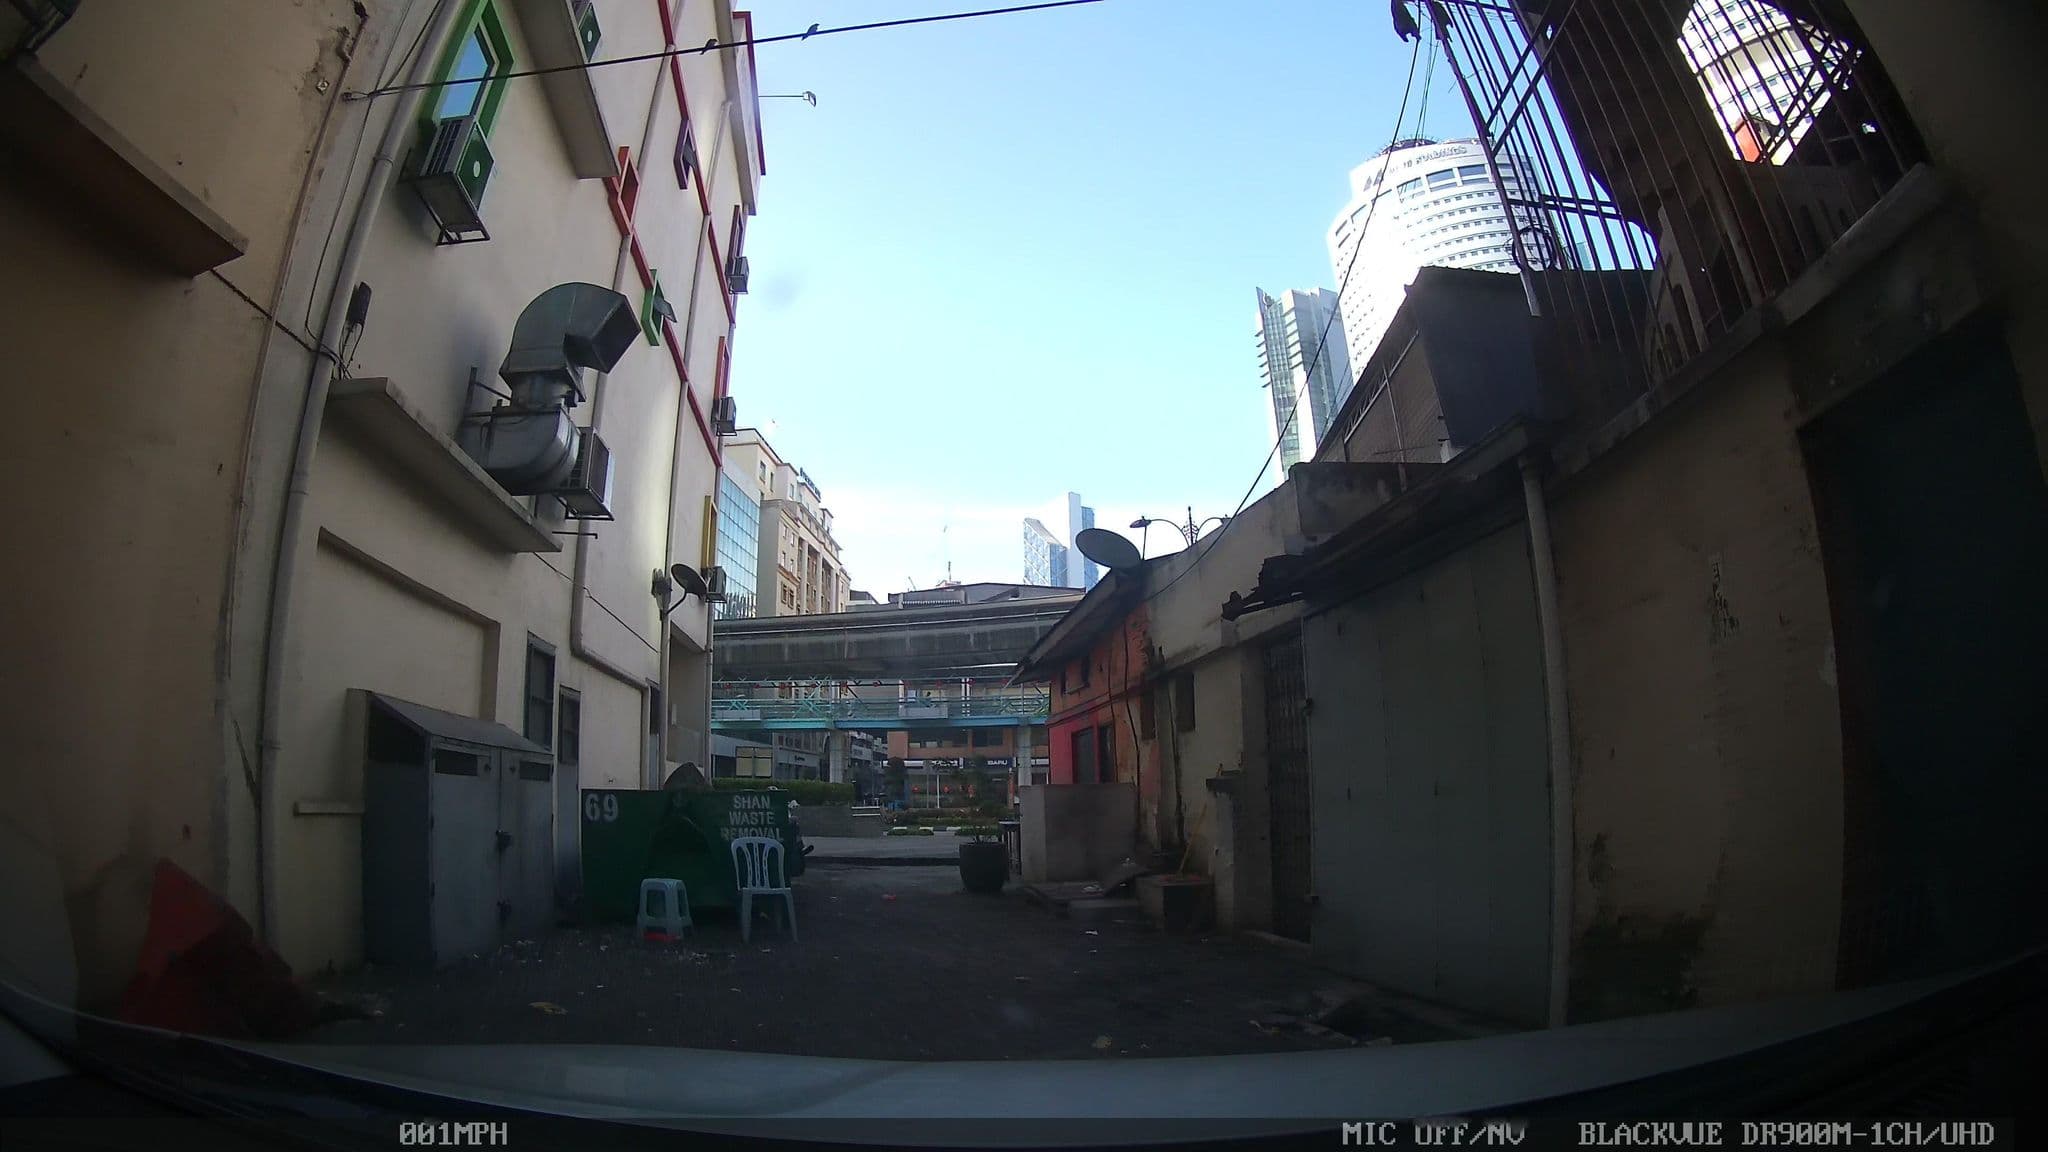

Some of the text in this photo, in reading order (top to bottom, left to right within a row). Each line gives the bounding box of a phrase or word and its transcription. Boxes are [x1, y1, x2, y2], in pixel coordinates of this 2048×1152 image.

[584, 792, 619, 822] 69
[733, 795, 771, 809] SHAN
[729, 811, 775, 825] WASTE
[721, 827, 784, 841] REMOVAL
